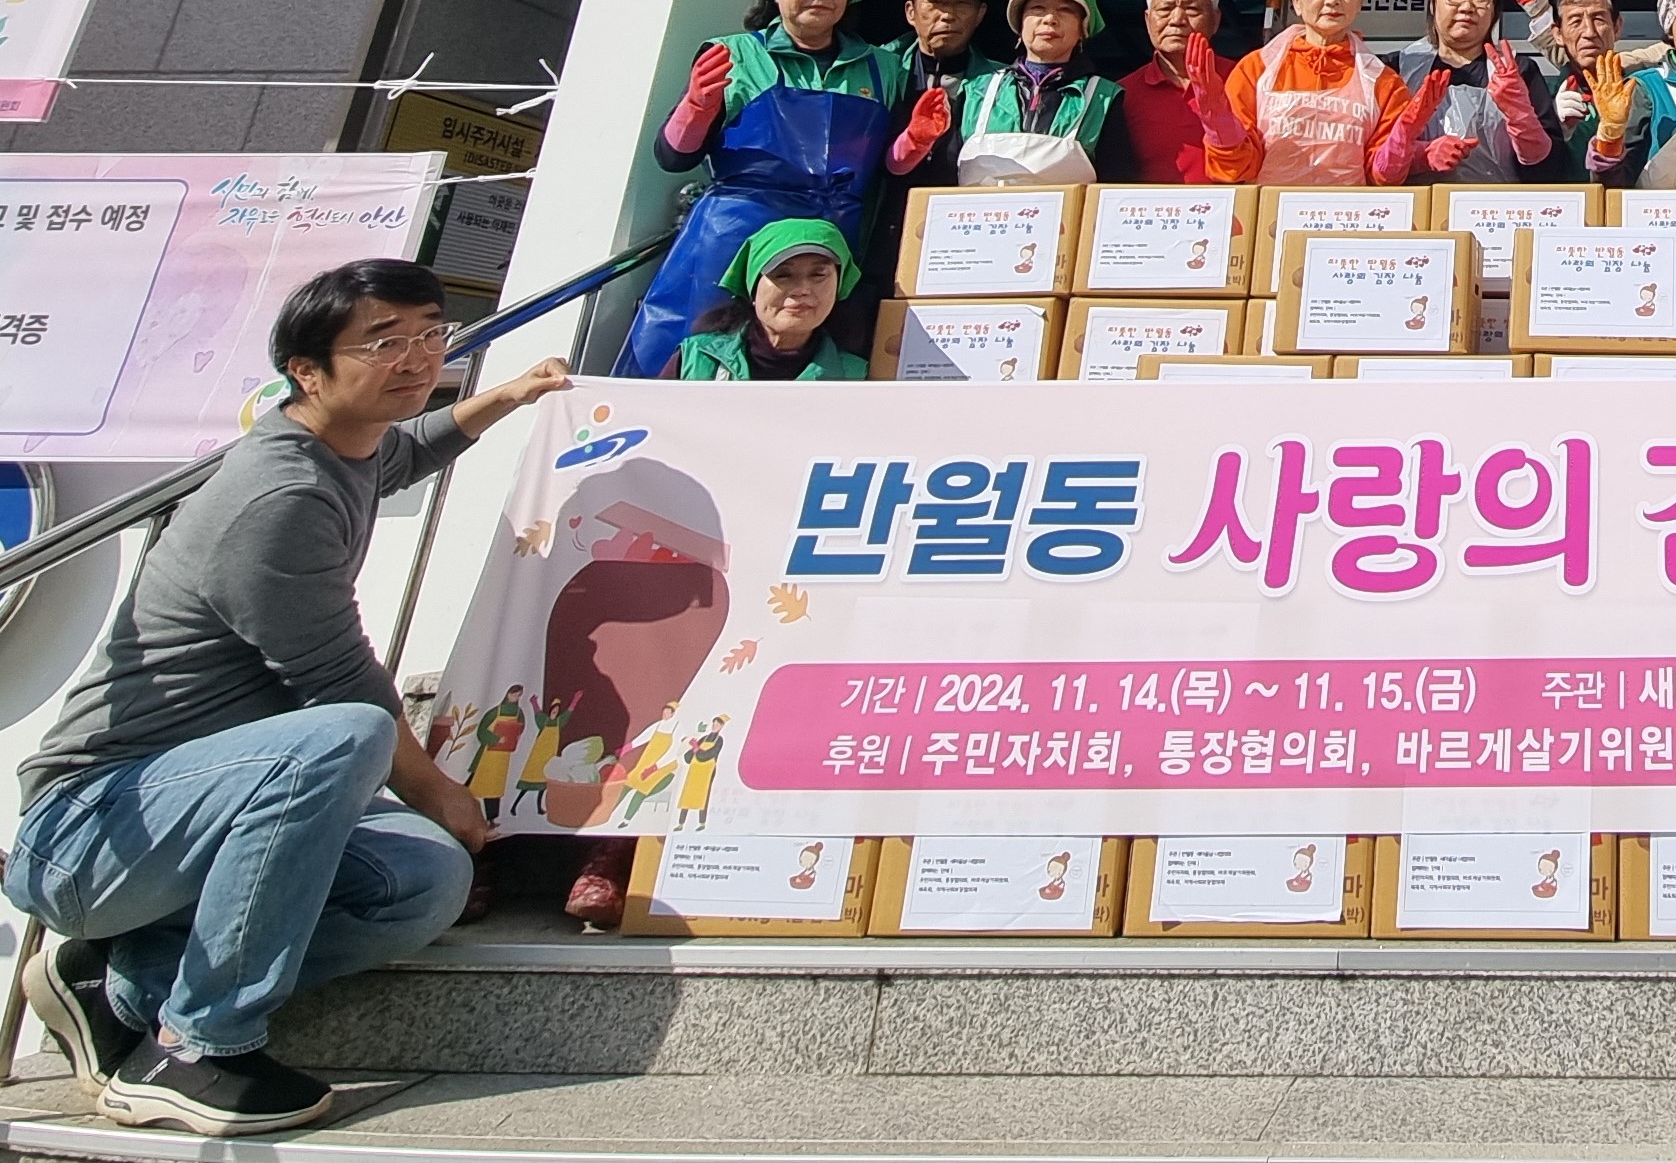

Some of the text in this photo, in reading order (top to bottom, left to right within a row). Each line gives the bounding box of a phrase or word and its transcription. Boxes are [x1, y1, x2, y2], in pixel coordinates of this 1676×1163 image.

[442, 116, 527, 159] 임시주거시설
[16, 204, 150, 233] 및 접수 예정
[359, 205, 409, 231] 안산
[1332, 272, 1423, 286] 사랑의 김장 나눔
[1560, 259, 1651, 272] 사랑의 김장 나눔
[0, 313, 50, 346] 격증
[783, 456, 1142, 578] 반월동
[1167, 438, 1595, 594] 사랑의
[840, 675, 906, 716] 기간
[936, 671, 1031, 716] 2024.
[1050, 671, 1100, 715] 11.
[1116, 670, 1233, 717] 14.(목)
[1294, 671, 1345, 715] 11.
[1360, 667, 1478, 716] 15.(금)
[1540, 671, 1606, 712] 주관
[822, 733, 888, 776] 후원
[920, 730, 1135, 779] 주민자치회,
[1157, 729, 1372, 778] 통장협의회,
